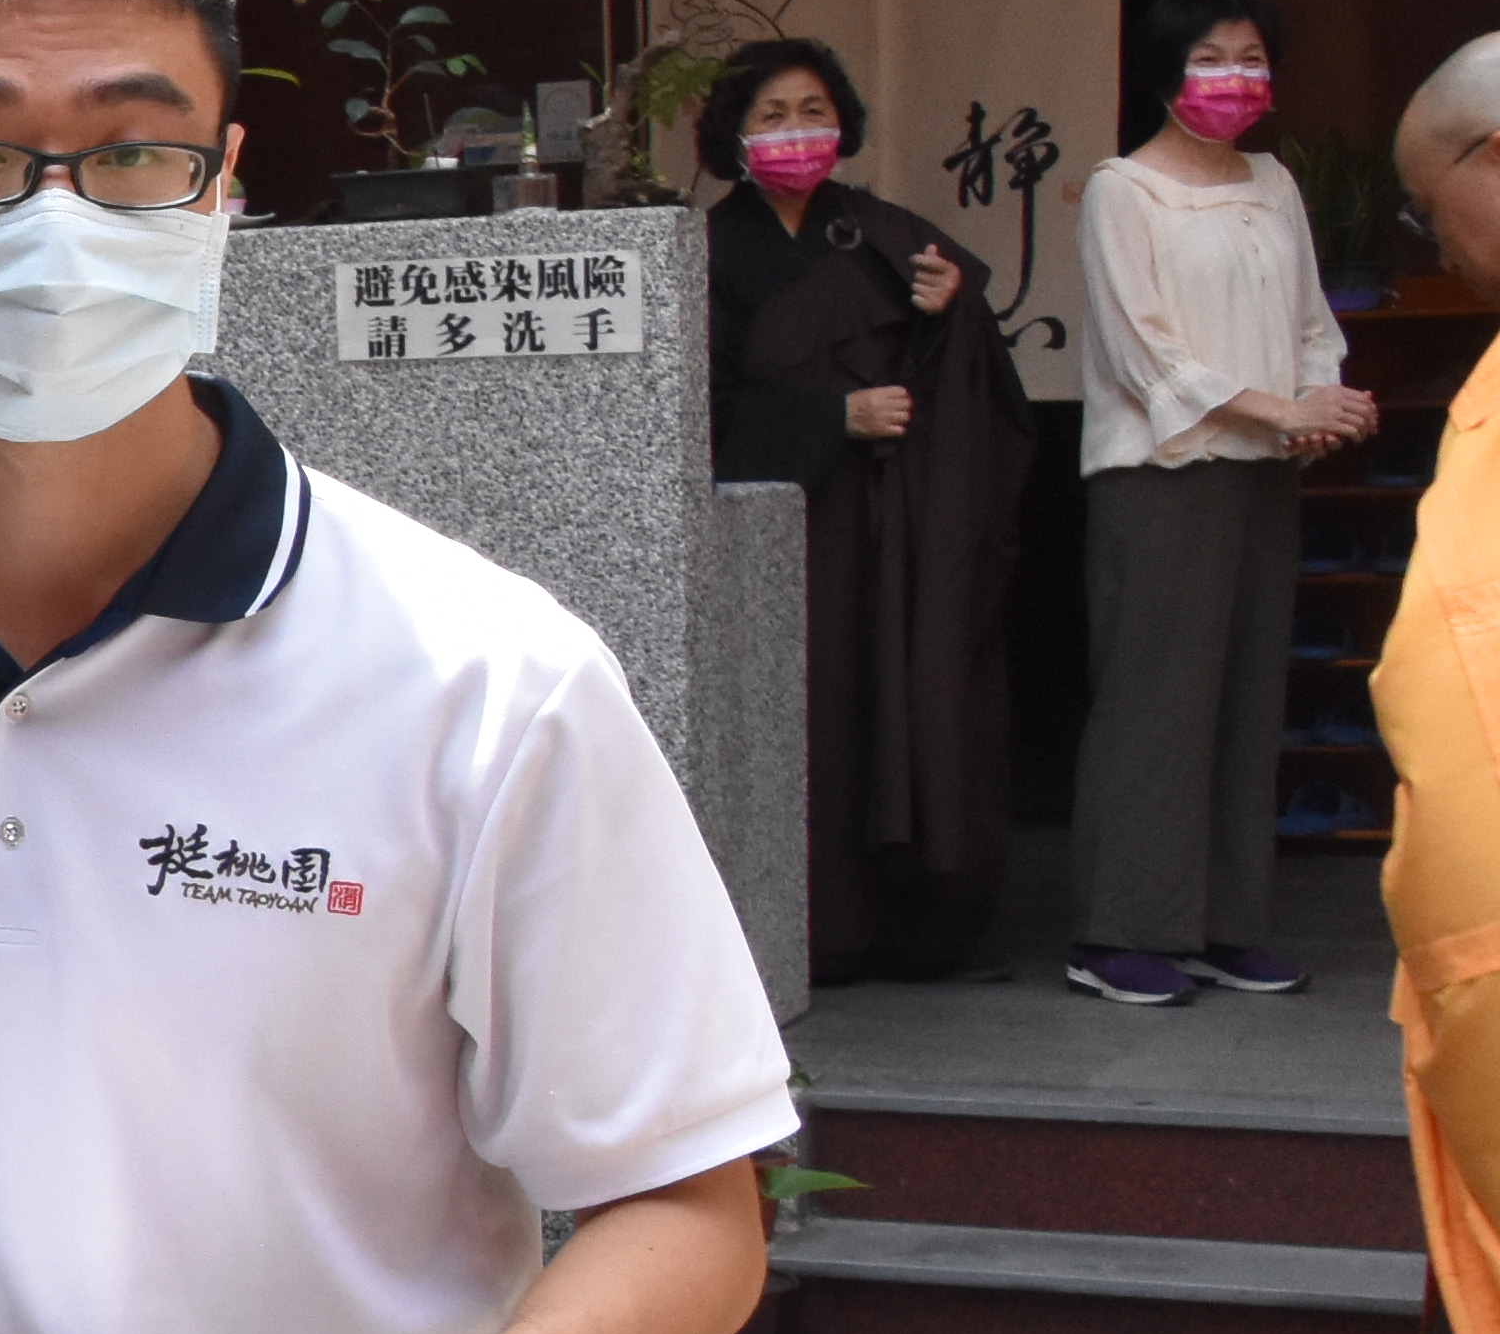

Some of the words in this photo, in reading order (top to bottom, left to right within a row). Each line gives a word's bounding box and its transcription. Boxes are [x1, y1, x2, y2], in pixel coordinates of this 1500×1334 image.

[353, 254, 626, 308] 避免感染風險
[367, 308, 616, 359] 請多洗手
[139, 822, 331, 896] 挺桃園
[180, 881, 232, 904] TEAM
[237, 888, 320, 915] TAOYUAN
